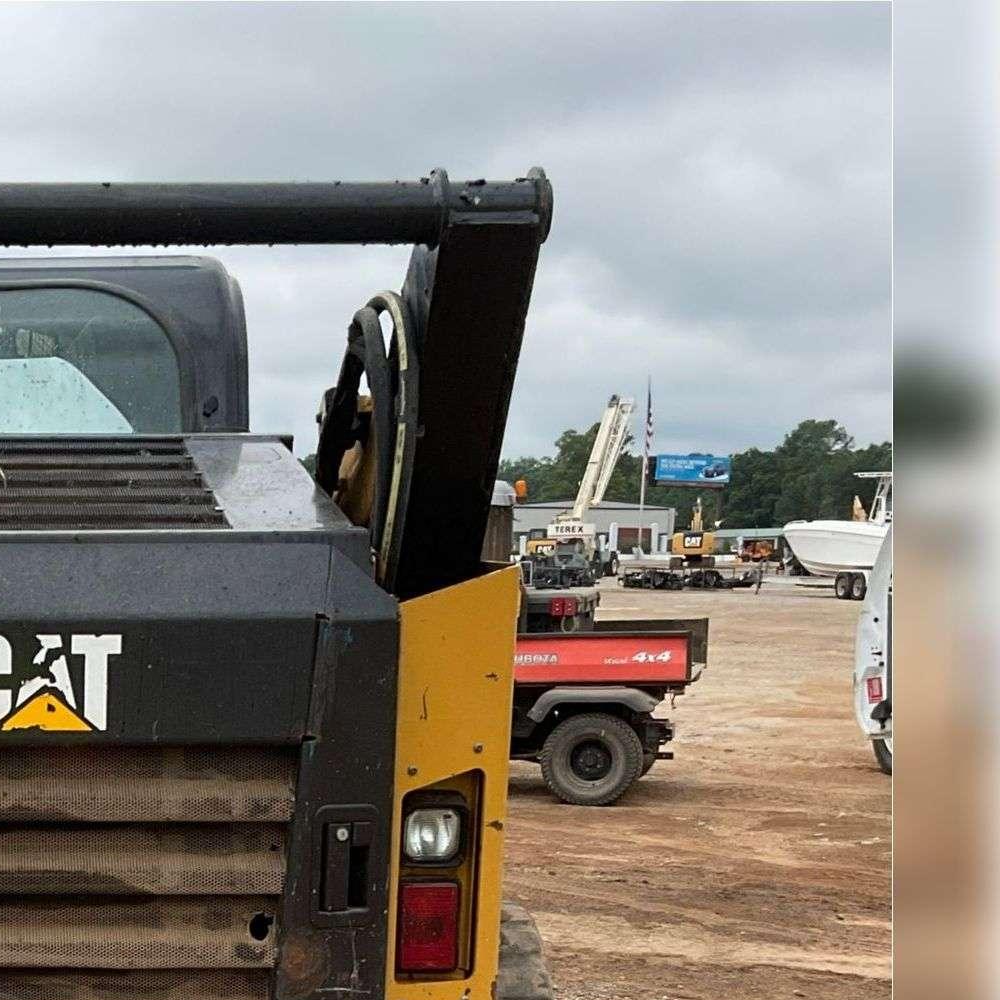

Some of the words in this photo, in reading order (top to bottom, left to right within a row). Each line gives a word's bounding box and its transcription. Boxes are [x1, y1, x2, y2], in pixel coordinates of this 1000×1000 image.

[555, 525, 584, 534] TEREX
[684, 536, 702, 547] CAT
[513, 653, 558, 664] UBOTA
[631, 650, 673, 664] 4x4
